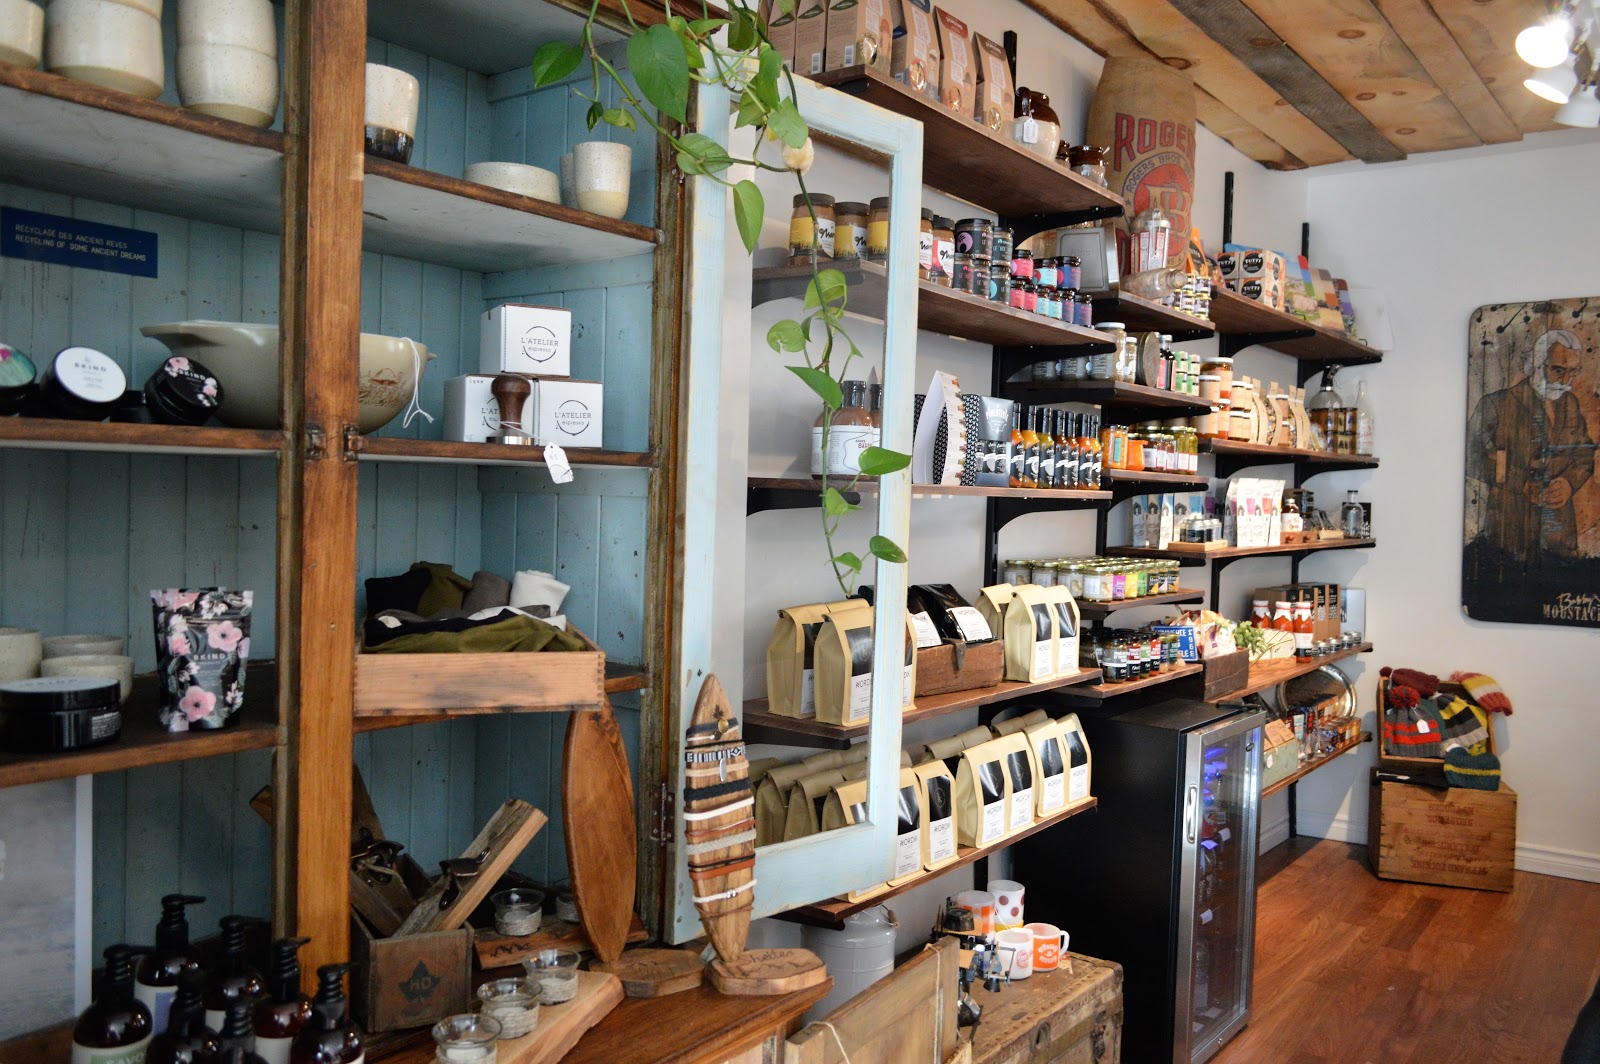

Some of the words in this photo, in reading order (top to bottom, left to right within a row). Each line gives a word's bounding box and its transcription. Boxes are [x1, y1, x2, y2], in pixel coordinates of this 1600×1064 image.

[1126, 160, 1155, 192] ROGERS
[15, 224, 55, 238] RECYCLAGE
[58, 232, 72, 241] DES
[75, 234, 104, 246] ANCIENS
[106, 239, 128, 249] REVES
[15, 235, 55, 247] RECYCLING
[56, 241, 66, 249] OF
[69, 243, 88, 253] SOME
[91, 247, 118, 257] ANCIENT
[120, 251, 146, 262] DREAMS
[520, 337, 559, 347] L'ATELIER
[554, 411, 592, 419] L'ATELIER
